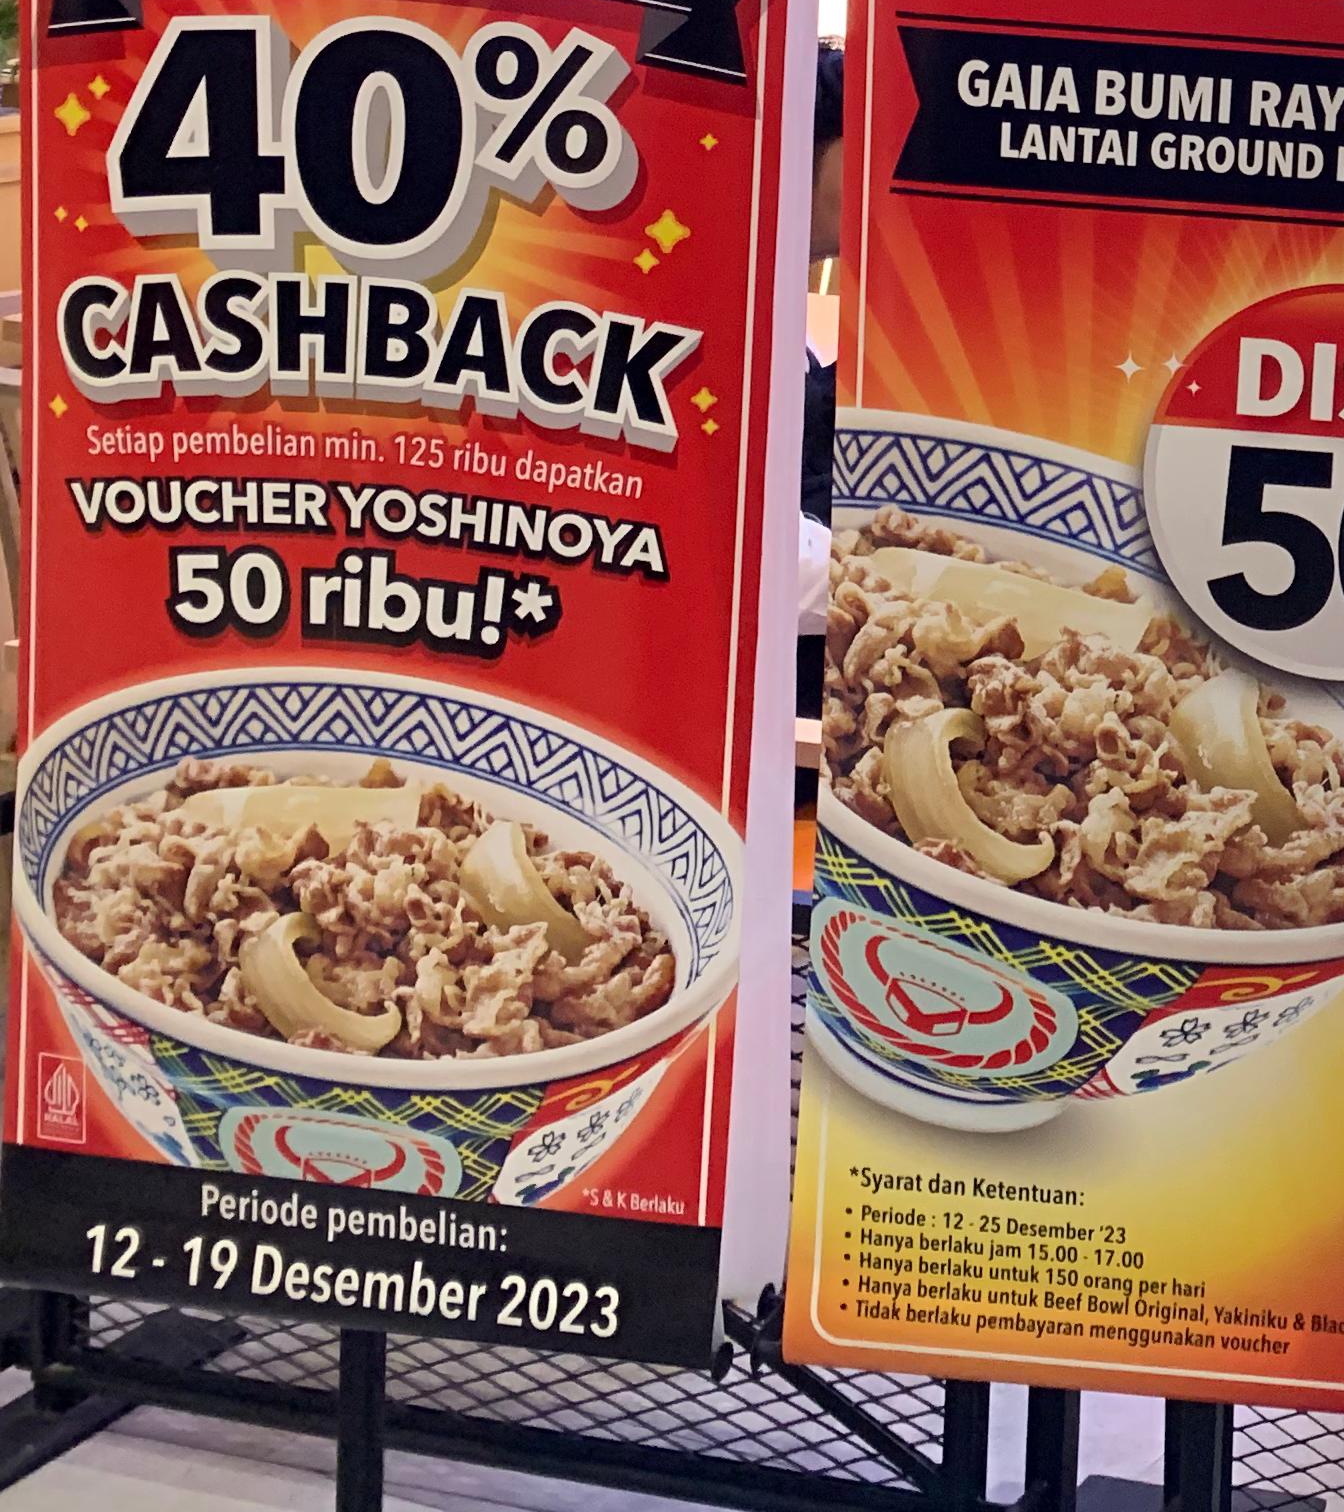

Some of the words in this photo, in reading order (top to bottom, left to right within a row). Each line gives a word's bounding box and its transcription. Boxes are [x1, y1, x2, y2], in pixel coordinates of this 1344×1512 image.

[957, 59, 1081, 114] GAIA
[1094, 70, 1232, 125] BUMI
[108, 15, 634, 253] 40%
[1000, 121, 1138, 168] LANTAI
[1150, 133, 1325, 181] GROUND
[57, 272, 704, 445] CASHBACK
[87, 425, 165, 463] Setiap
[172, 426, 316, 461] pembelian
[324, 430, 386, 463] min.
[394, 435, 445, 471] 125
[452, 442, 508, 479] ribu
[514, 449, 645, 500] dapatkan
[71, 480, 329, 529] VOUCHER
[337, 485, 666, 574] YOSHINOYA
[173, 553, 286, 626] 50
[199, 1182, 318, 1232] Periode
[326, 1204, 509, 1254] pembelian:
[928, 1172, 966, 1196] dan
[972, 1177, 1086, 1207] Ketentuan:
[860, 1204, 926, 1228] Periode
[942, 1211, 964, 1230] 12
[979, 1215, 1001, 1234] 25
[1006, 1218, 1096, 1242] Desember
[860, 1227, 914, 1252] Hanya
[919, 1232, 984, 1257] berlaku
[988, 1238, 1022, 1262] jam
[1028, 1242, 1079, 1265] 15.00
[1093, 1248, 1145, 1270] 17.00
[85, 1224, 138, 1279] 12
[182, 1236, 239, 1290] 19
[252, 1252, 488, 1322] Desember
[496, 1273, 621, 1339] 2023
[857, 1274, 912, 1301] Hanya
[917, 1279, 982, 1304] berlaku
[987, 1286, 1039, 1308] untuk
[1044, 1290, 1082, 1312] Beef
[1087, 1294, 1130, 1317] Bowl
[1133, 1298, 1209, 1327] Original,
[1213, 1305, 1289, 1331] Yakiniku
[1292, 1313, 1306, 1331] &
[859, 1251, 914, 1277] Hanya
[918, 1255, 984, 1280] berlaku
[989, 1262, 1040, 1285] untuk
[1045, 1267, 1079, 1288] 150
[1083, 1274, 1134, 1298] orang
[1138, 1276, 1168, 1298] per
[1172, 1277, 1206, 1299] hari
[855, 1299, 901, 1322] Tidak
[905, 1303, 972, 1328] berlaku
[975, 1312, 1085, 1339] pembayaran
[1089, 1322, 1216, 1350] menggunakan
[1220, 1334, 1291, 1356] voucher
